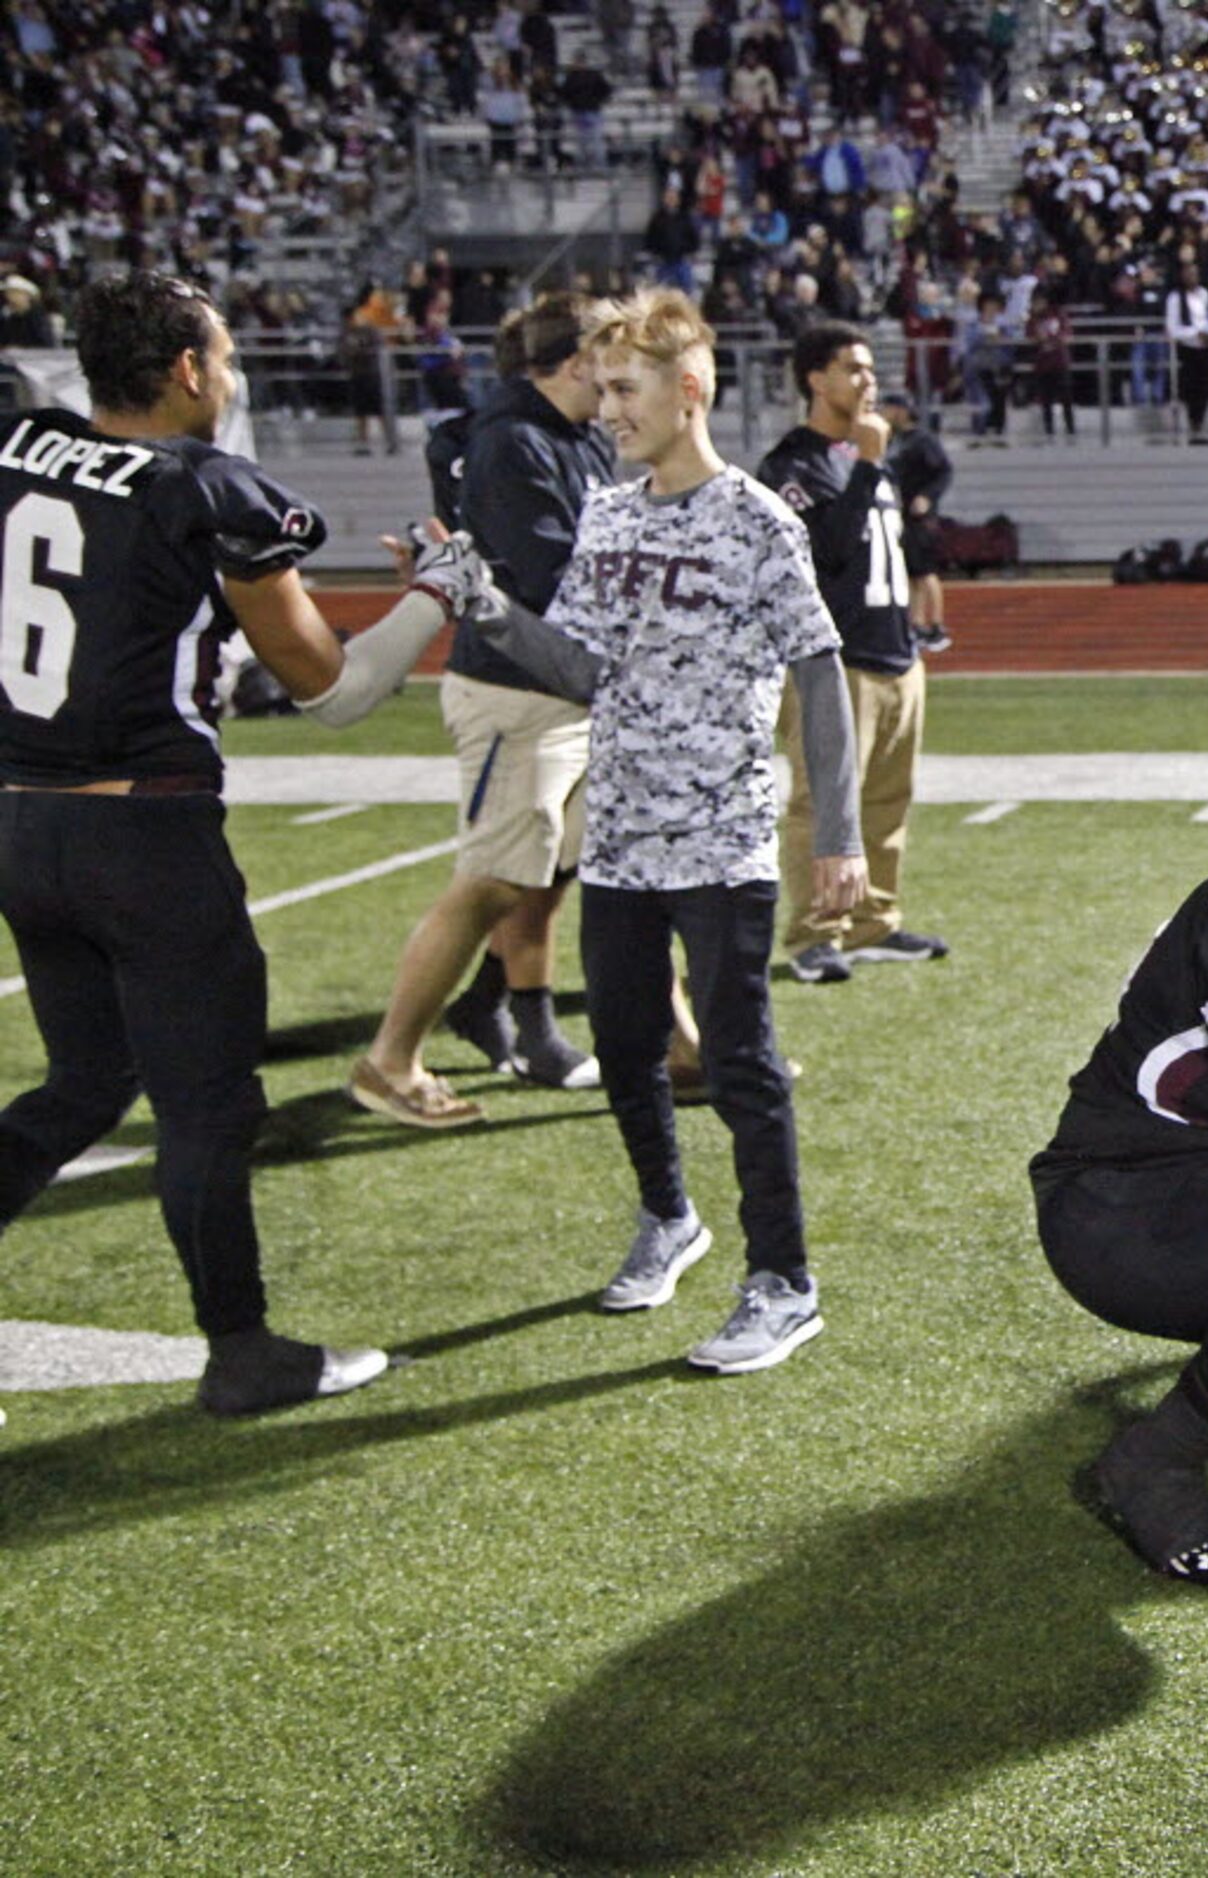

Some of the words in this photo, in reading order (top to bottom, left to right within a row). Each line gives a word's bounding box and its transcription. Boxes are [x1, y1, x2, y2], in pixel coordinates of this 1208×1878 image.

[0, 419, 154, 497] LOPEZ
[0, 491, 84, 720] 6
[594, 551, 716, 611] PFC
